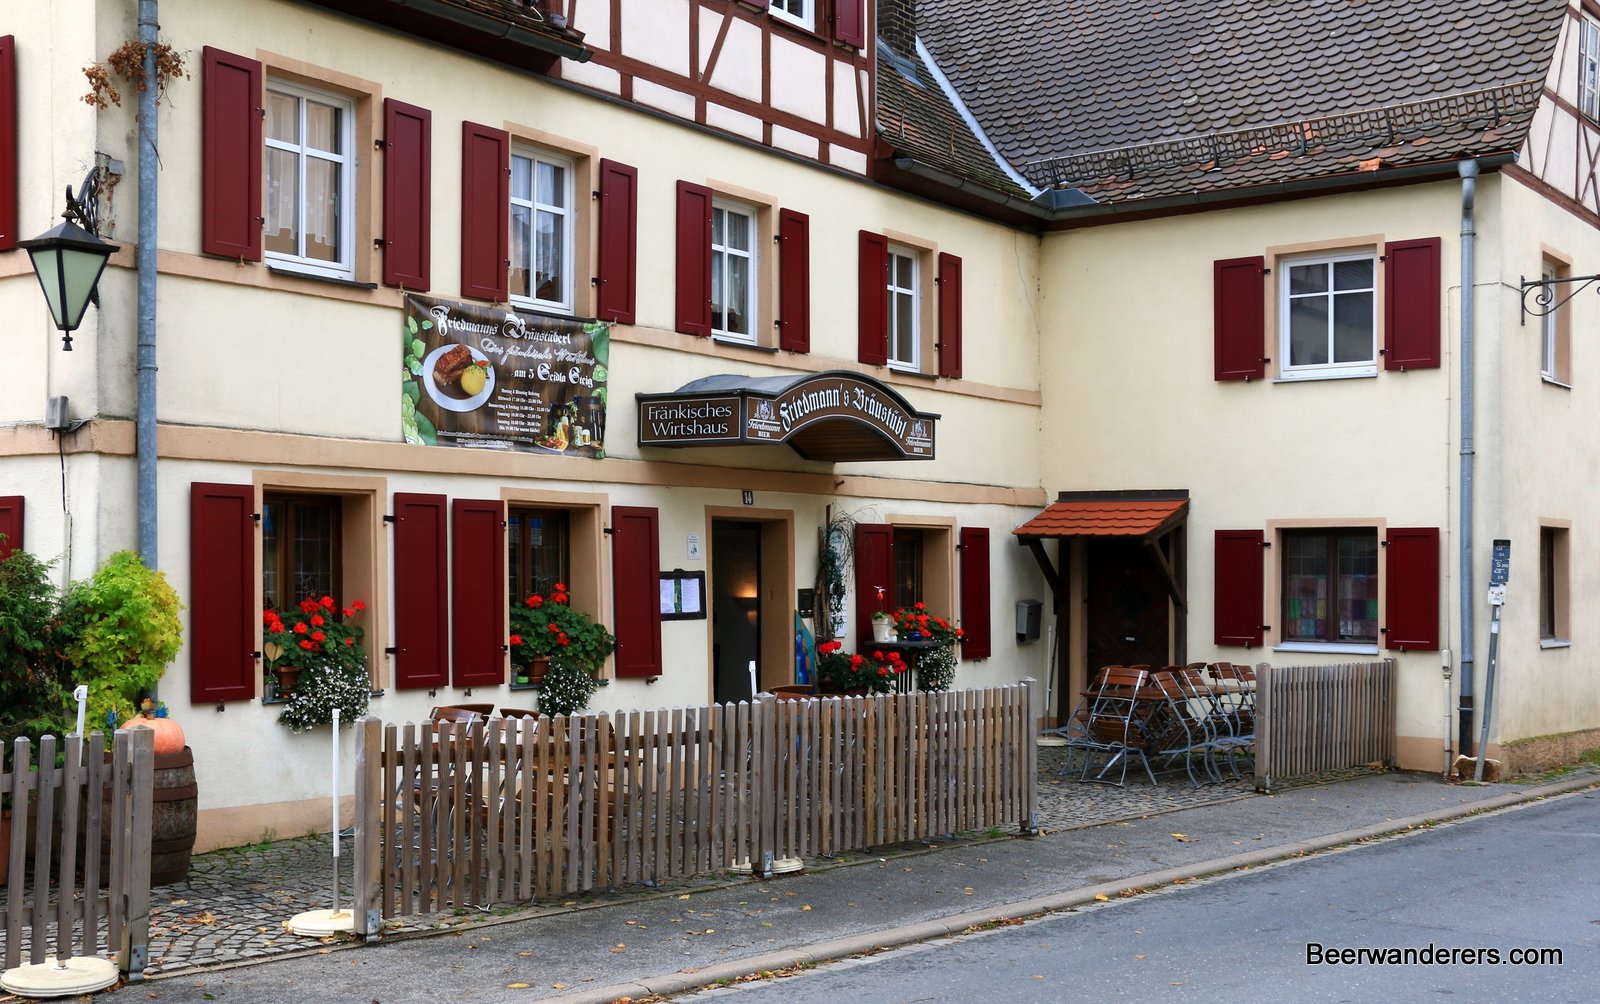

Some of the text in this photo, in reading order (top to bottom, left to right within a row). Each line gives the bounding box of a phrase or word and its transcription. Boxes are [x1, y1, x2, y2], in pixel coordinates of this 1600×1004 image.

[430, 306, 571, 344] Friedmanns Bräustüberl
[528, 368, 534, 378] 5
[537, 362, 566, 383] Seidla
[568, 366, 593, 387] Steig
[648, 402, 732, 420] Fränkisches
[780, 382, 907, 438] Friedmann's Bräustübl
[652, 419, 728, 436] Wirtshaus
[748, 418, 781, 432] Friedmann
[745, 491, 752, 504] 14
